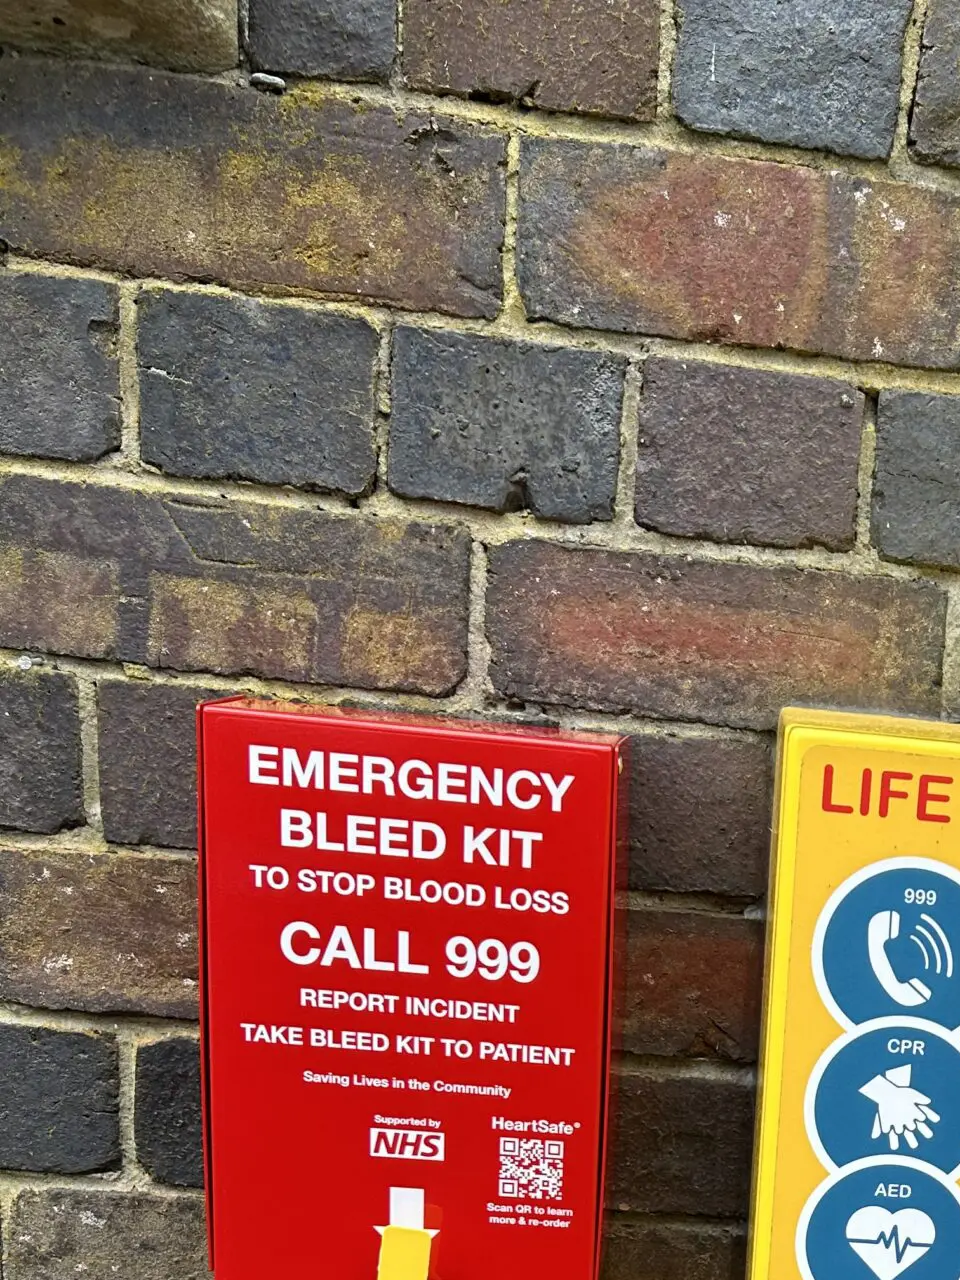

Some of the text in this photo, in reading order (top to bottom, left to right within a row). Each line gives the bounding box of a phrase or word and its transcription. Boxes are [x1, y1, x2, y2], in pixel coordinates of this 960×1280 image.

[248, 744, 576, 813] EMERGENCY
[822, 765, 953, 823] LIFE
[281, 809, 543, 868] BLEED KIT
[249, 865, 569, 914] TO STOP BLOOD LOSS
[905, 889, 936, 905] 999
[280, 921, 539, 983] CALL 999
[301, 988, 520, 1023] REPORT INCIDENT
[240, 1023, 575, 1066] TAKE BLEED KIT TO PATIENT
[888, 1039, 924, 1055] CPR
[304, 1071, 511, 1098] Saving Lives in the Community
[374, 1115, 440, 1128] Supported by
[374, 1131, 441, 1157] NHS
[875, 1184, 911, 1197] AED
[487, 1203, 573, 1217] Scan QR to learn
[489, 1216, 570, 1228] more & re-order
